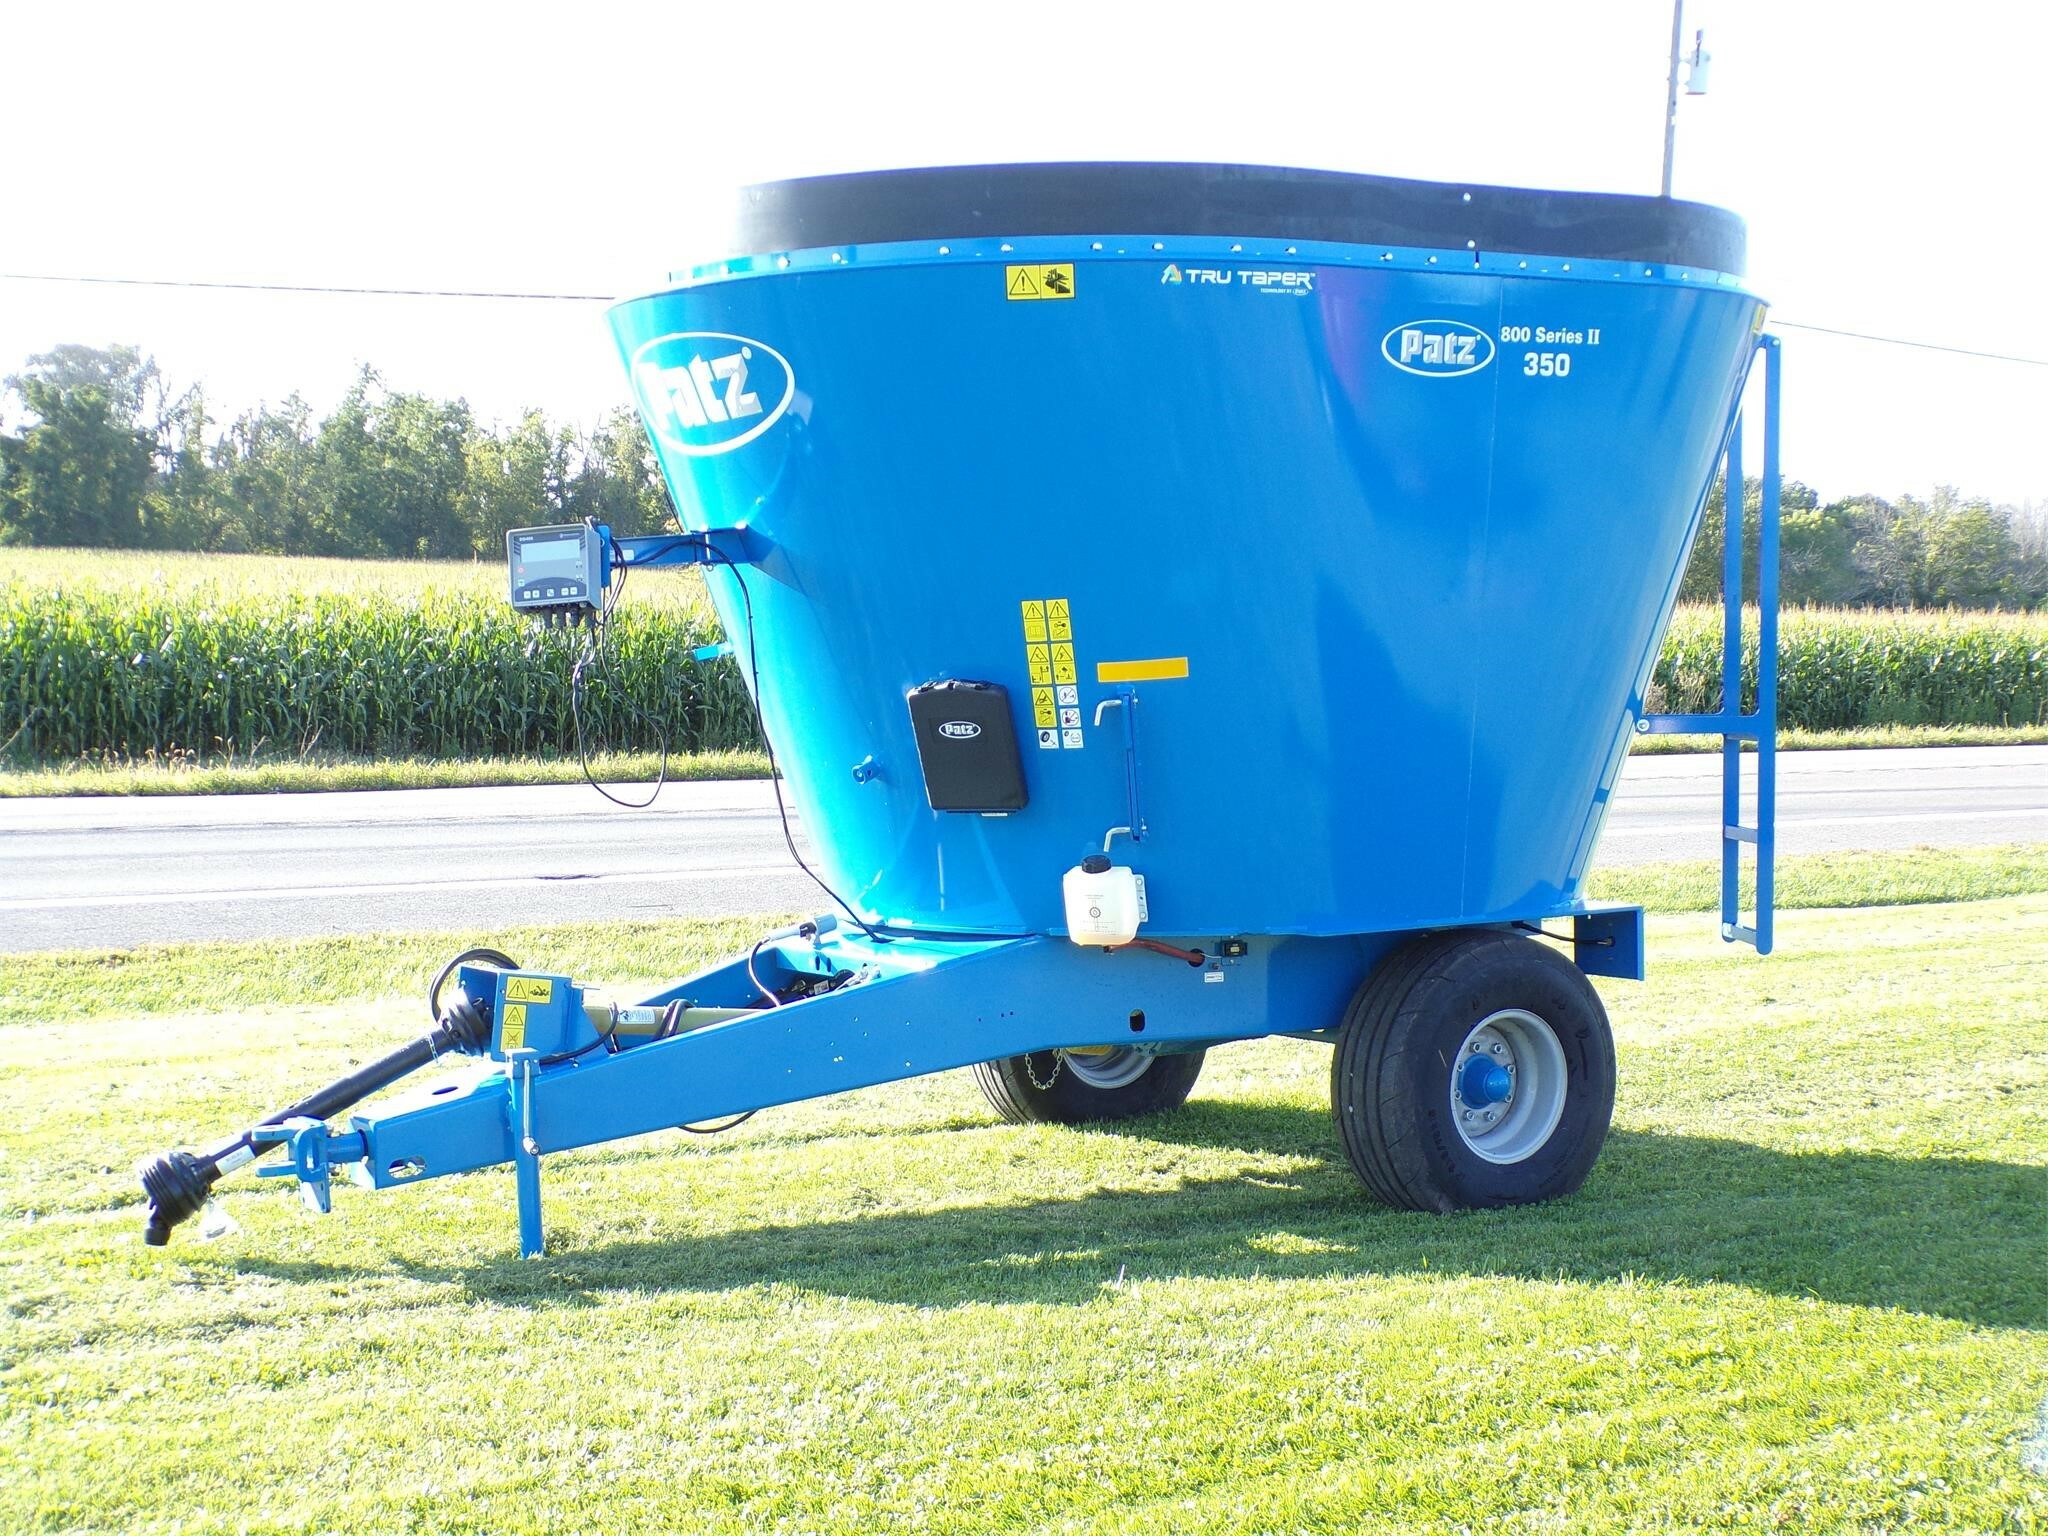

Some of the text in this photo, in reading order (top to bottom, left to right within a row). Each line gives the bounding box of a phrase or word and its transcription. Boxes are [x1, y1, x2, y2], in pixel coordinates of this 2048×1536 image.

[1185, 268, 1232, 285] TRU
[1500, 326, 1600, 345] 800 Series II
[1400, 328, 1477, 366] Patz
[1523, 352, 1571, 377] 350
[944, 724, 975, 736] Patz
